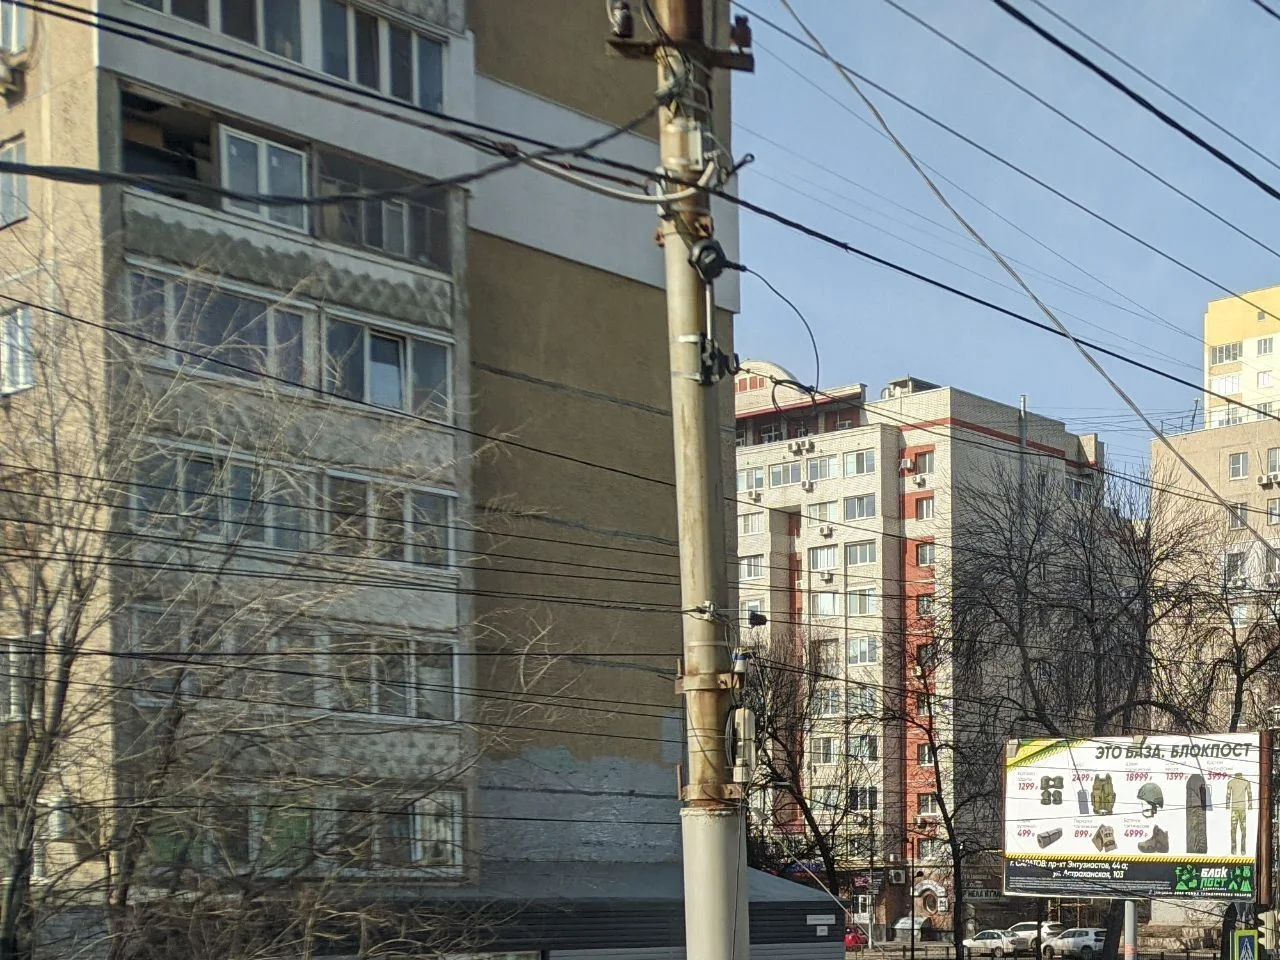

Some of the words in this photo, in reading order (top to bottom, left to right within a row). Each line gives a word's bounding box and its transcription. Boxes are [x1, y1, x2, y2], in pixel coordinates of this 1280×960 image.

[1095, 746, 1122, 759] ЭТО
[1170, 743, 1252, 758] БЛОКПОСТ
[1018, 782, 1035, 790] 1299
[1017, 829, 1032, 837] 499
[1074, 829, 1089, 838] 899
[1123, 829, 1144, 838] 4999
[1112, 861, 1121, 869] 44
[1113, 871, 1125, 879] 103
